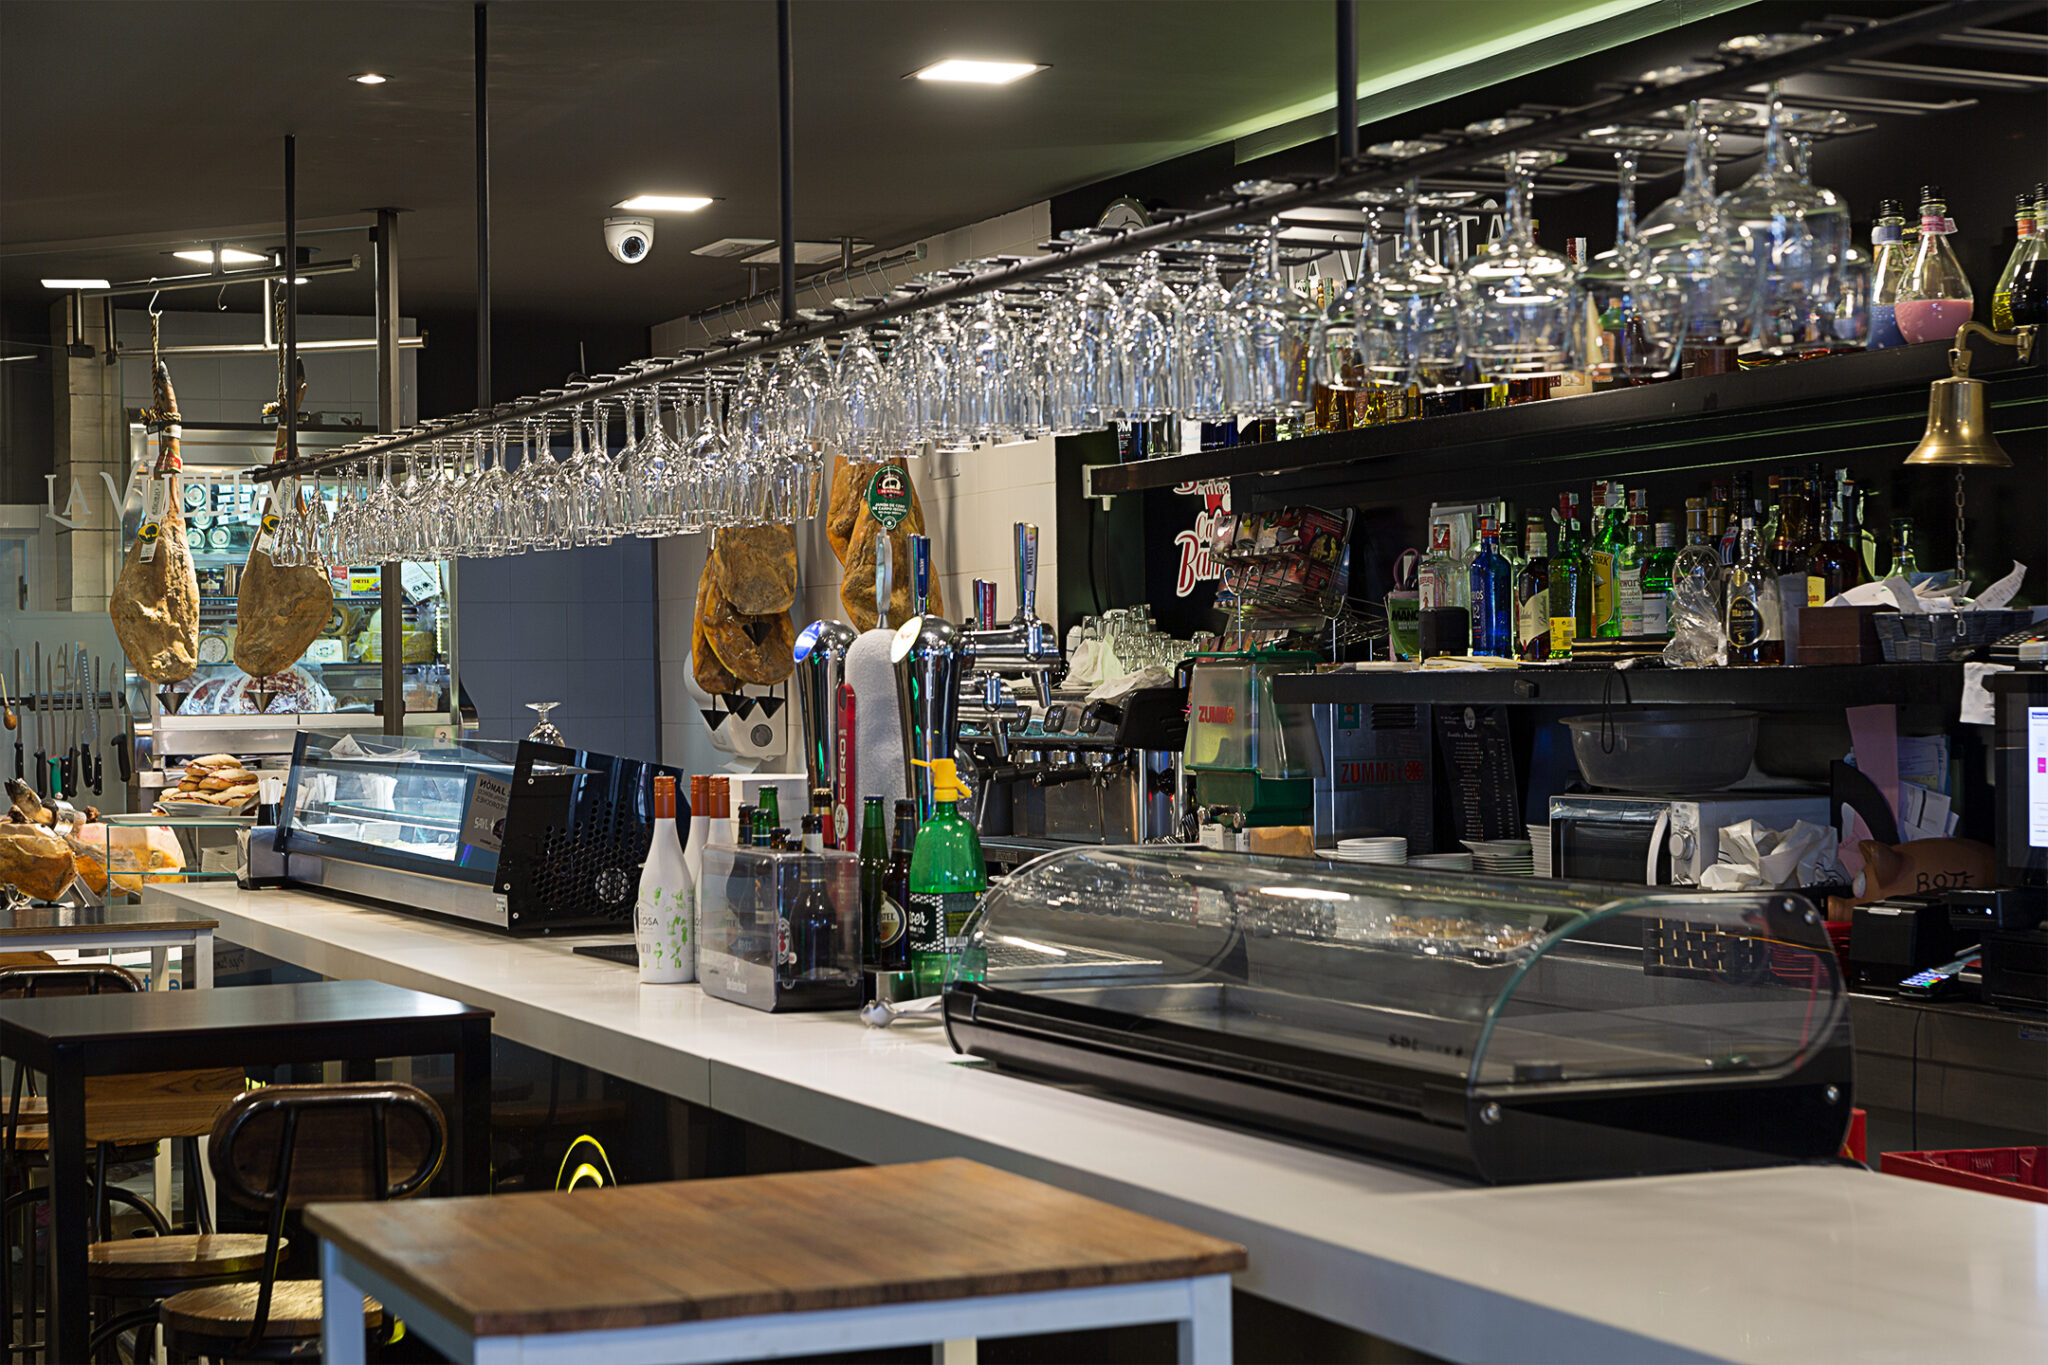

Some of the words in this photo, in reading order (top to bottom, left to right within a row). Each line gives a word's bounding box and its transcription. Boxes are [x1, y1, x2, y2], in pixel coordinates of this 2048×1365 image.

[45, 474, 92, 528] LA
[99, 456, 283, 522] VUELTA
[839, 738, 847, 803] CERO
[1916, 870, 1975, 894] BOTE
